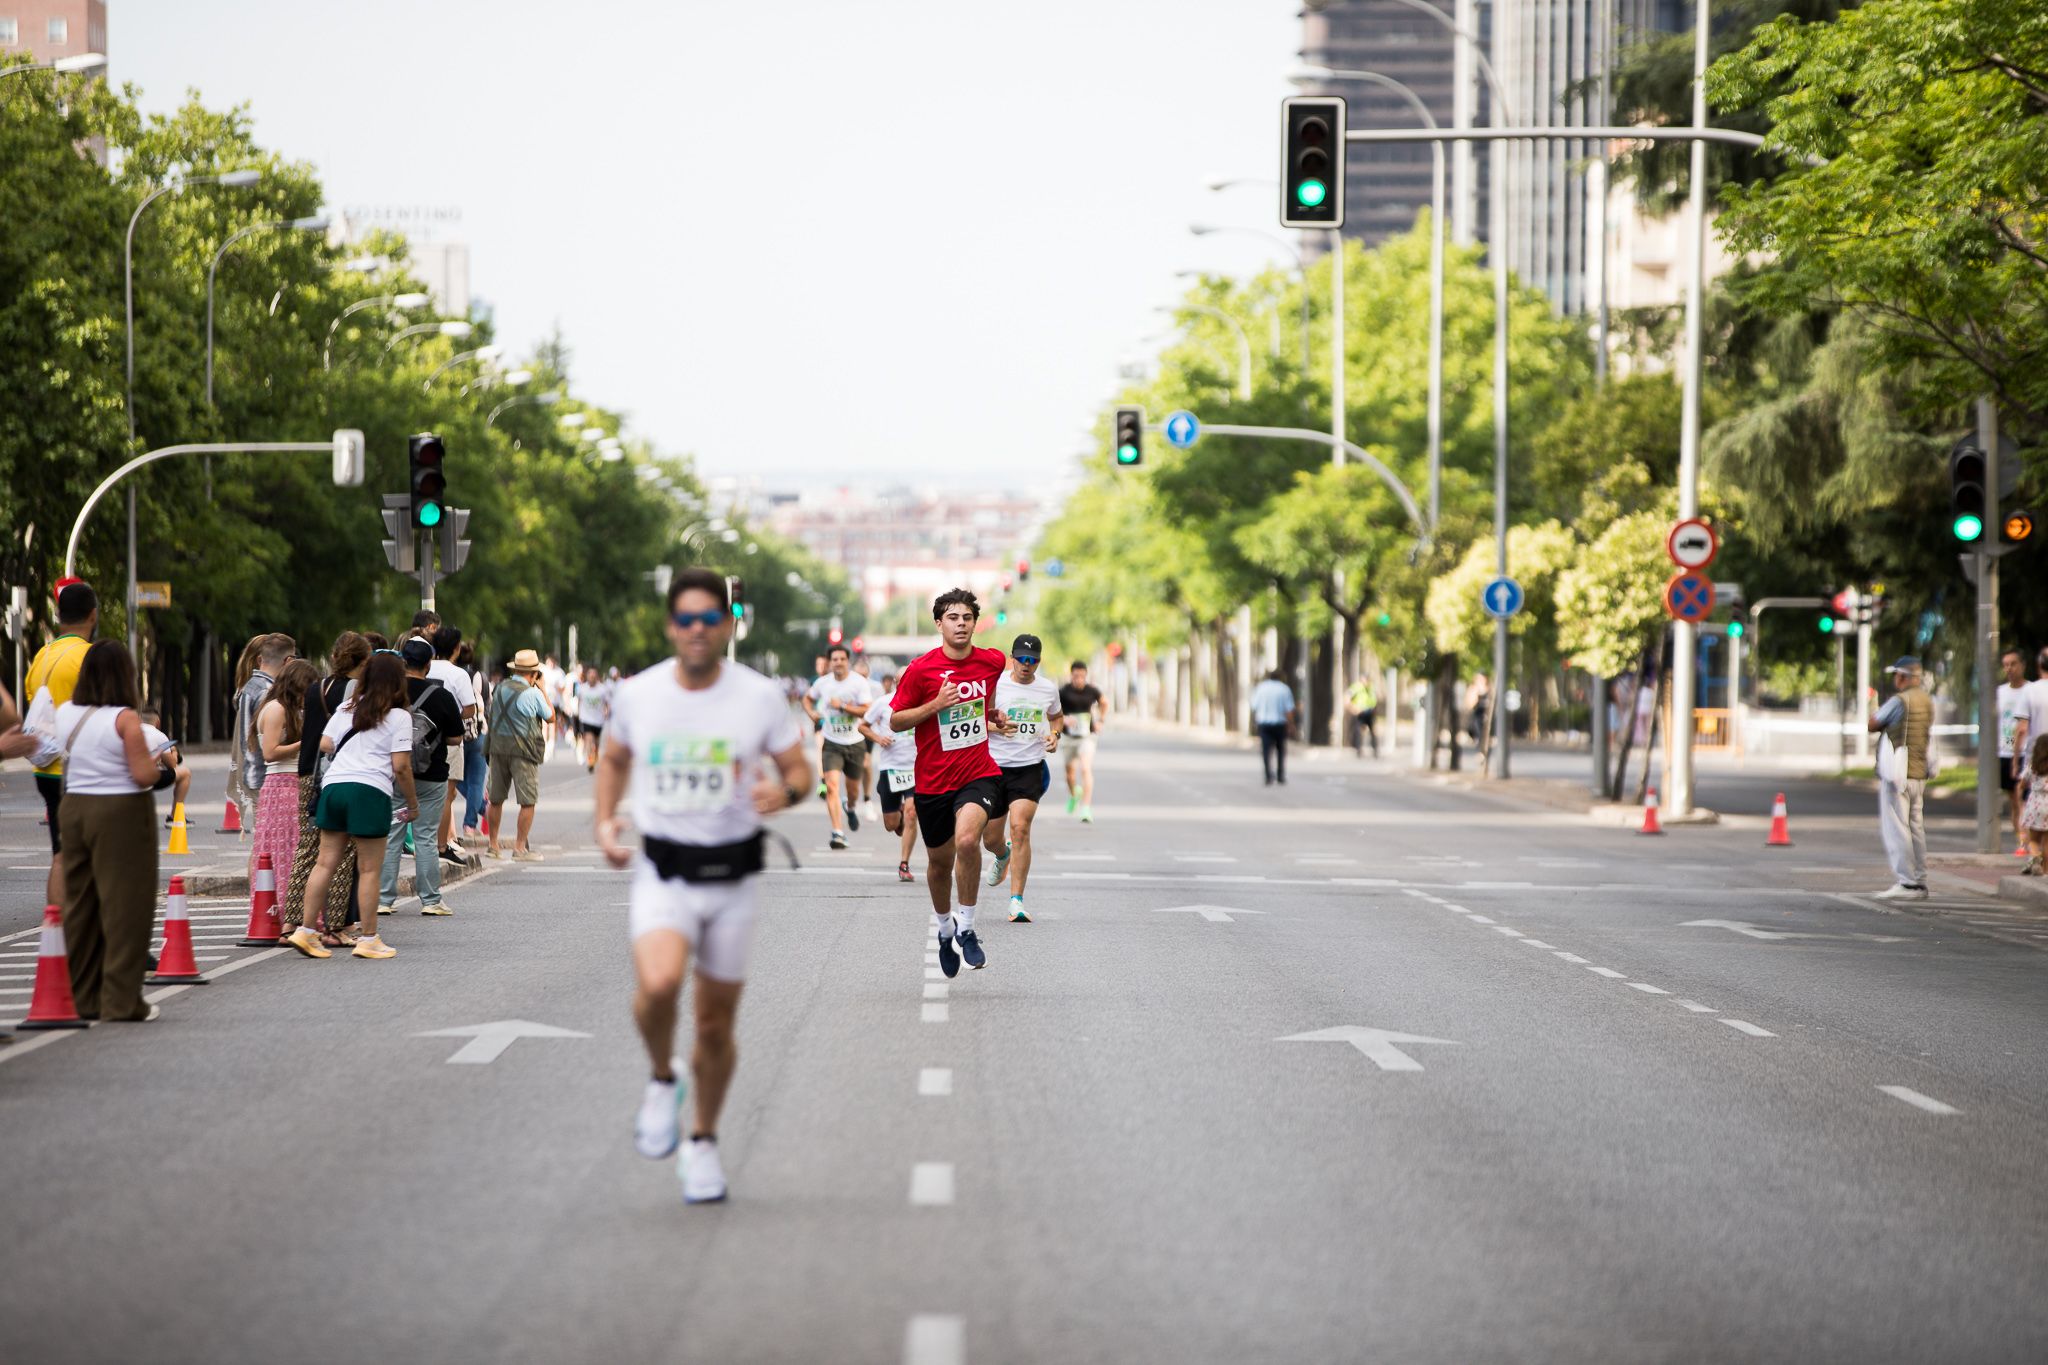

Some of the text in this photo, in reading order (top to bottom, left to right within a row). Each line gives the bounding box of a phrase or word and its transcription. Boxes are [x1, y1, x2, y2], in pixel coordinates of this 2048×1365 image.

[948, 680, 986, 698] ON
[949, 705, 977, 722] ELA
[1015, 711, 1035, 721] ELA
[950, 720, 981, 739] 696
[1017, 723, 1036, 734] 03
[656, 768, 724, 796] 1790
